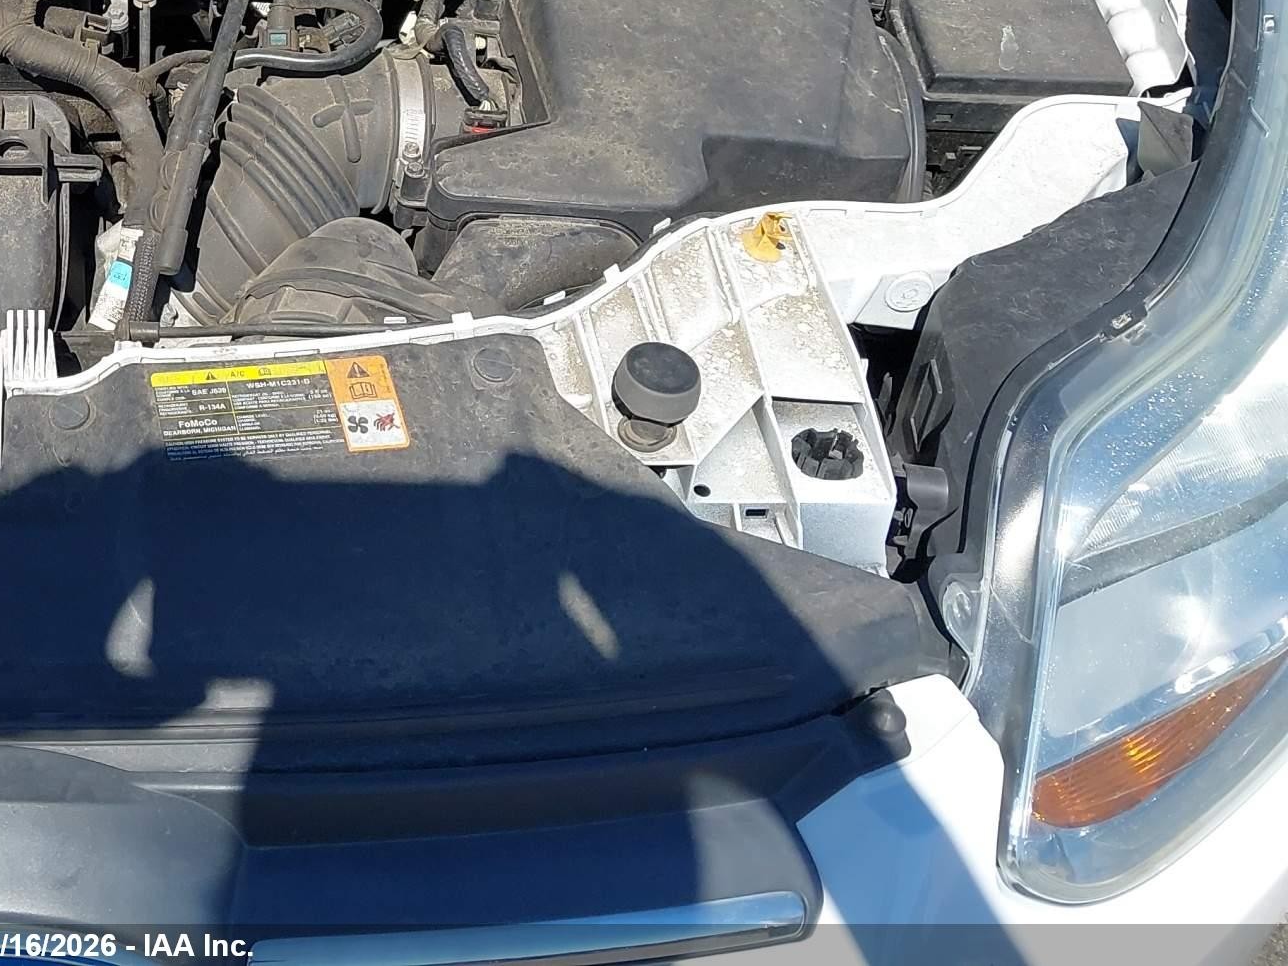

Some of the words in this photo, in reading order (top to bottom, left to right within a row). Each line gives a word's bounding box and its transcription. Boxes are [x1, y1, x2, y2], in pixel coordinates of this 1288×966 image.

[230, 370, 245, 379] A/C
[191, 388, 208, 396] SAE
[198, 403, 226, 412] R-134A
[178, 418, 218, 429] FoMoCo
